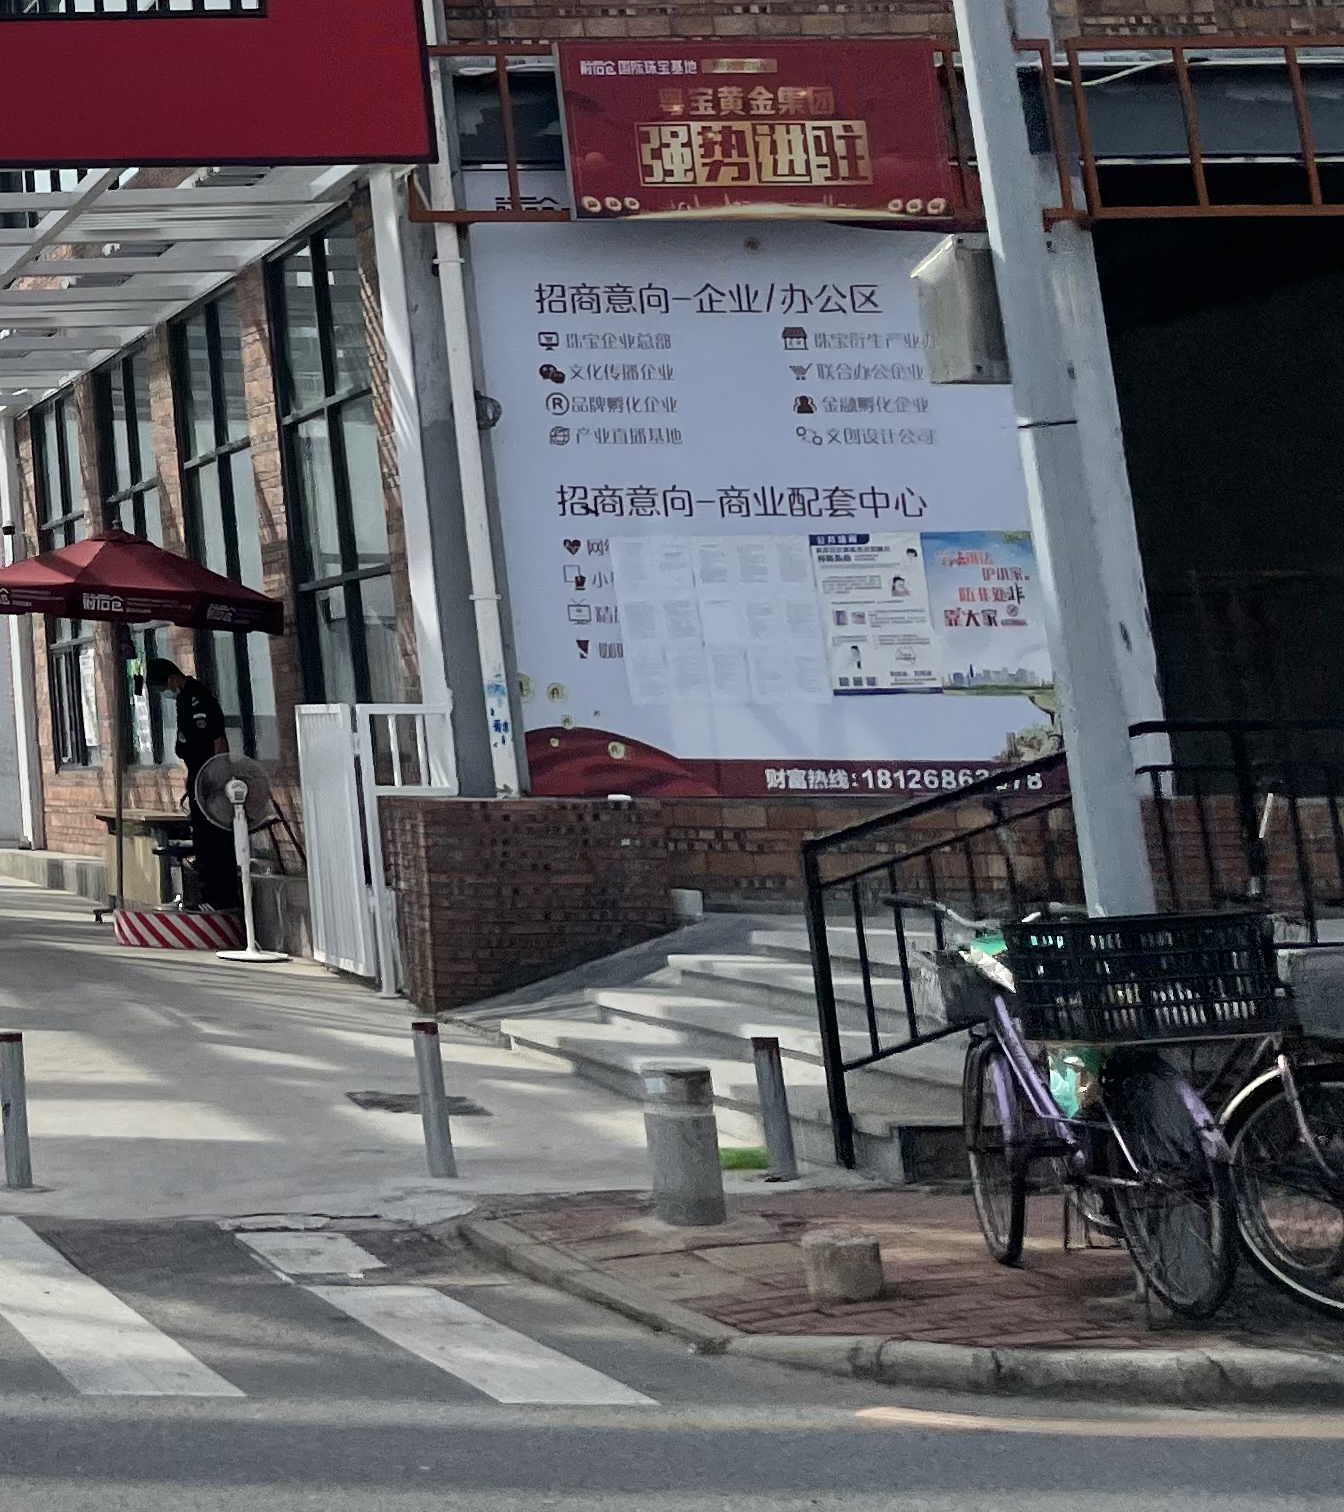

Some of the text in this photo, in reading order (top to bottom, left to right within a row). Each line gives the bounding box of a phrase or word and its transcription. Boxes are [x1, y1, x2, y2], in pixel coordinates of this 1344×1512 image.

[640, 123, 869, 185] 强势进驻
[568, 363, 675, 381] 文化传播企业
[571, 396, 677, 413] 品牌孵化企业
[575, 426, 683, 445] 产业直播基地
